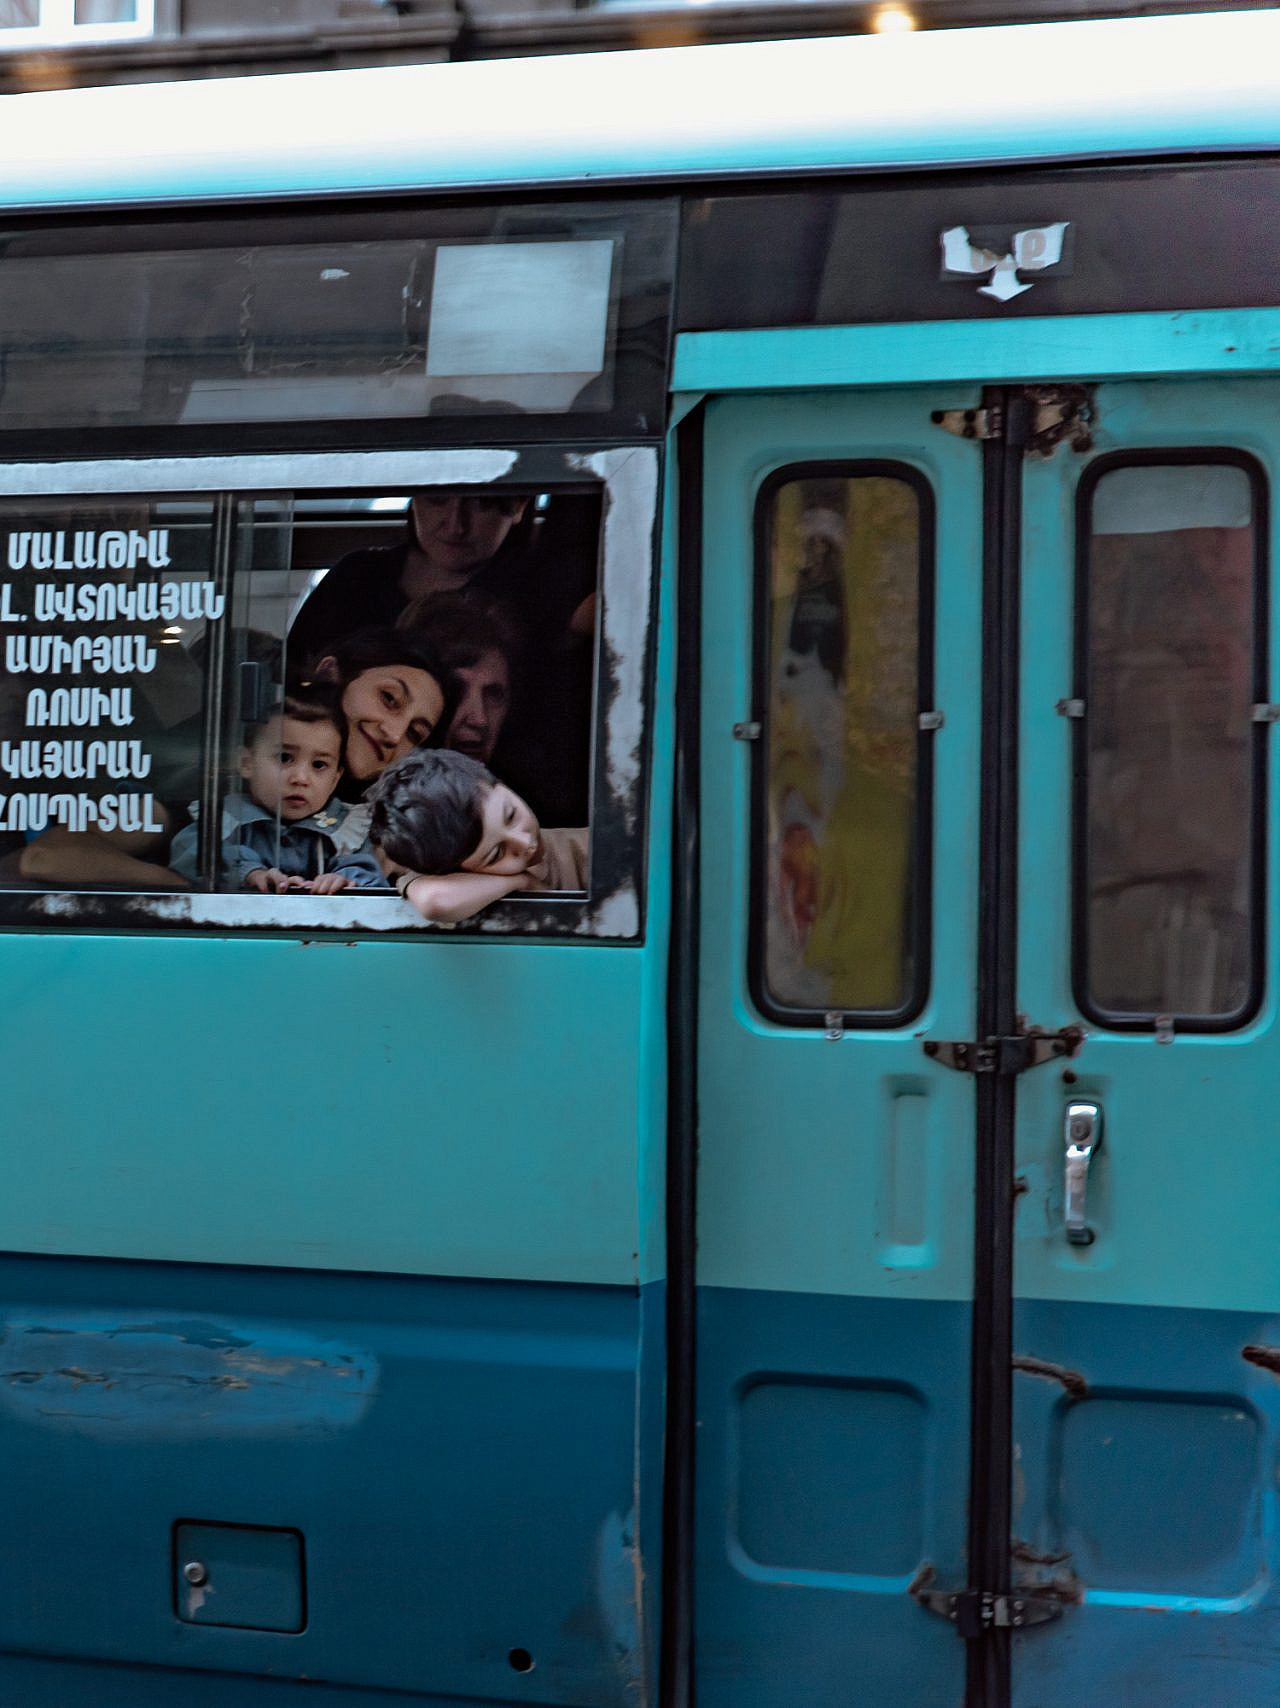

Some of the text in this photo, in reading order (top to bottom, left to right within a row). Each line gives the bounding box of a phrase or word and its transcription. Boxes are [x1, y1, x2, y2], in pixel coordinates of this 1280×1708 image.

[8, 530, 172, 570] ՄԱԼԱԹԻԱ
[34, 581, 224, 622] ԱՎՏՈԿԱՅԱՆ
[6, 634, 157, 674] ԱՄԻՐՅԱՆ
[26, 687, 135, 726] ՌՈՍԻԱ
[0, 740, 152, 780] ԿԱՅԱՐԱՆ
